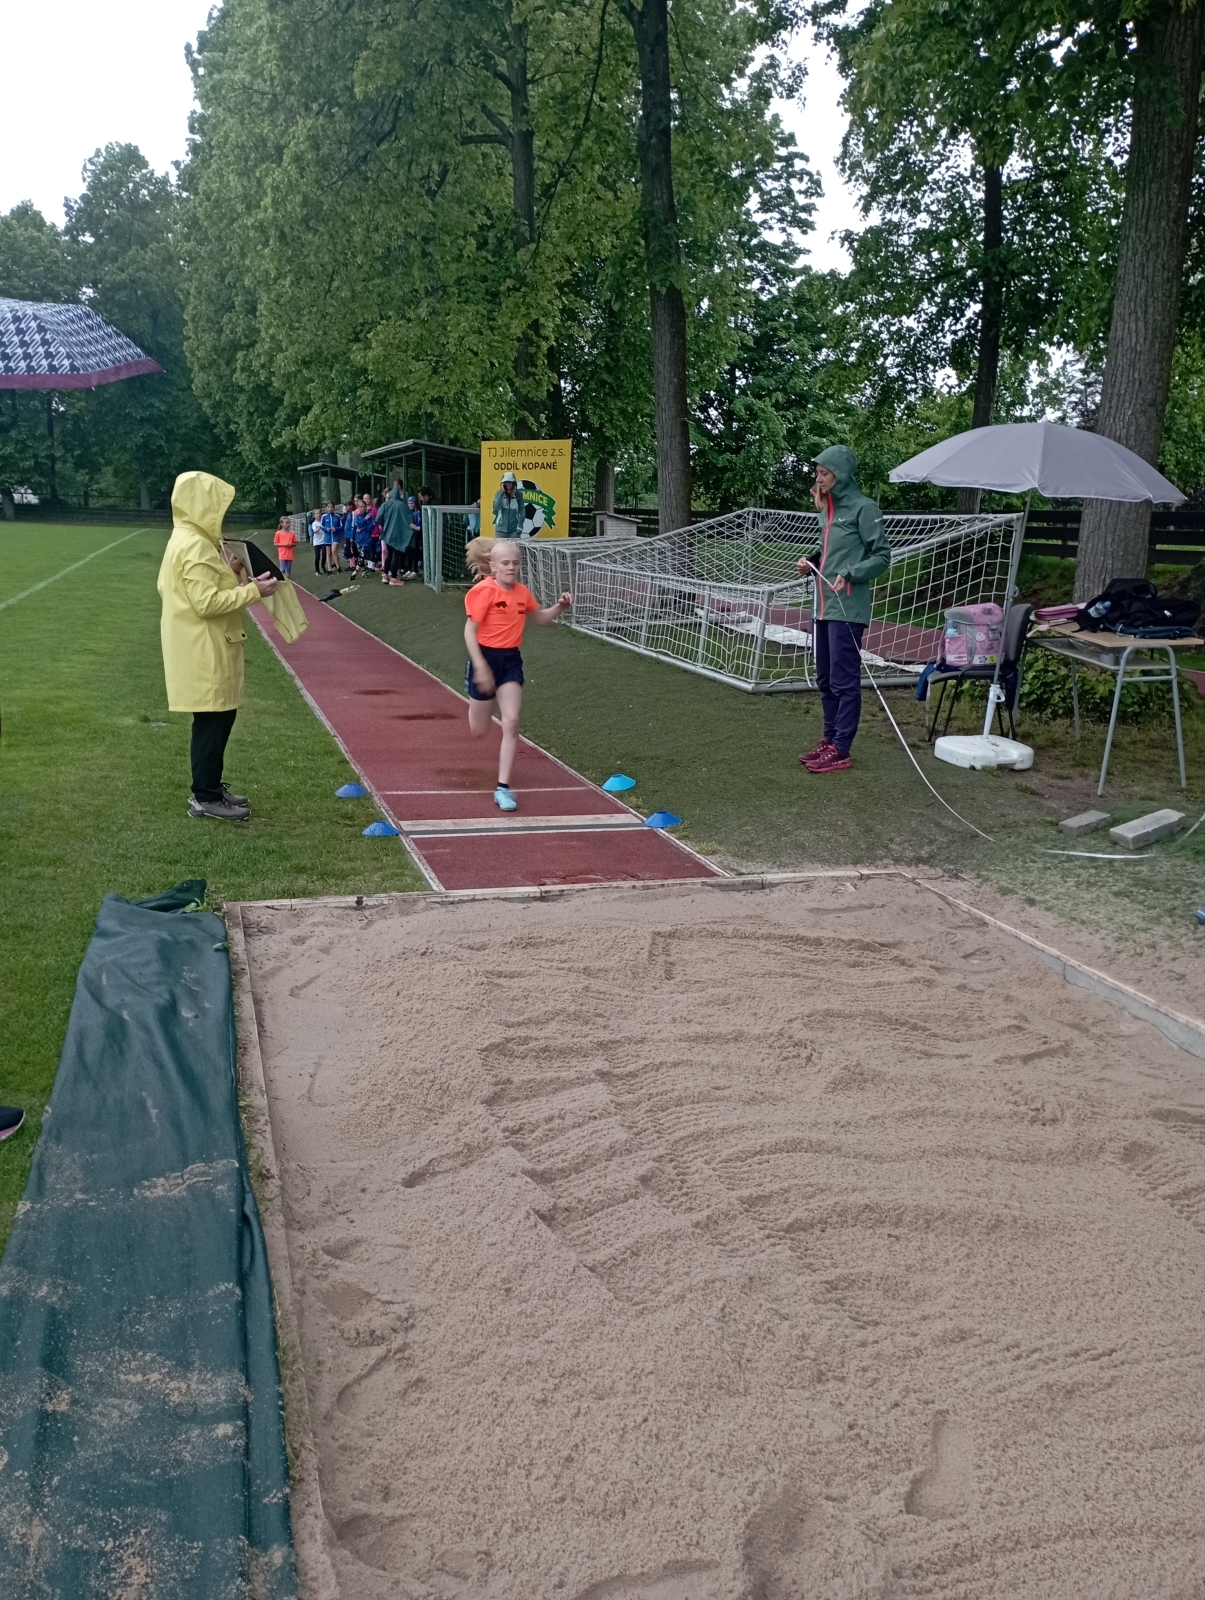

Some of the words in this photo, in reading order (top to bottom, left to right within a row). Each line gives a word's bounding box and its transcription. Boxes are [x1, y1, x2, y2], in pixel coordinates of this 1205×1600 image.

[487, 447, 497, 458] TJ
[499, 446, 548, 458] Jilemnice
[493, 460, 520, 470] ODDÍL
[522, 459, 558, 470] KOPANÉ
[521, 491, 548, 507] MNICE
